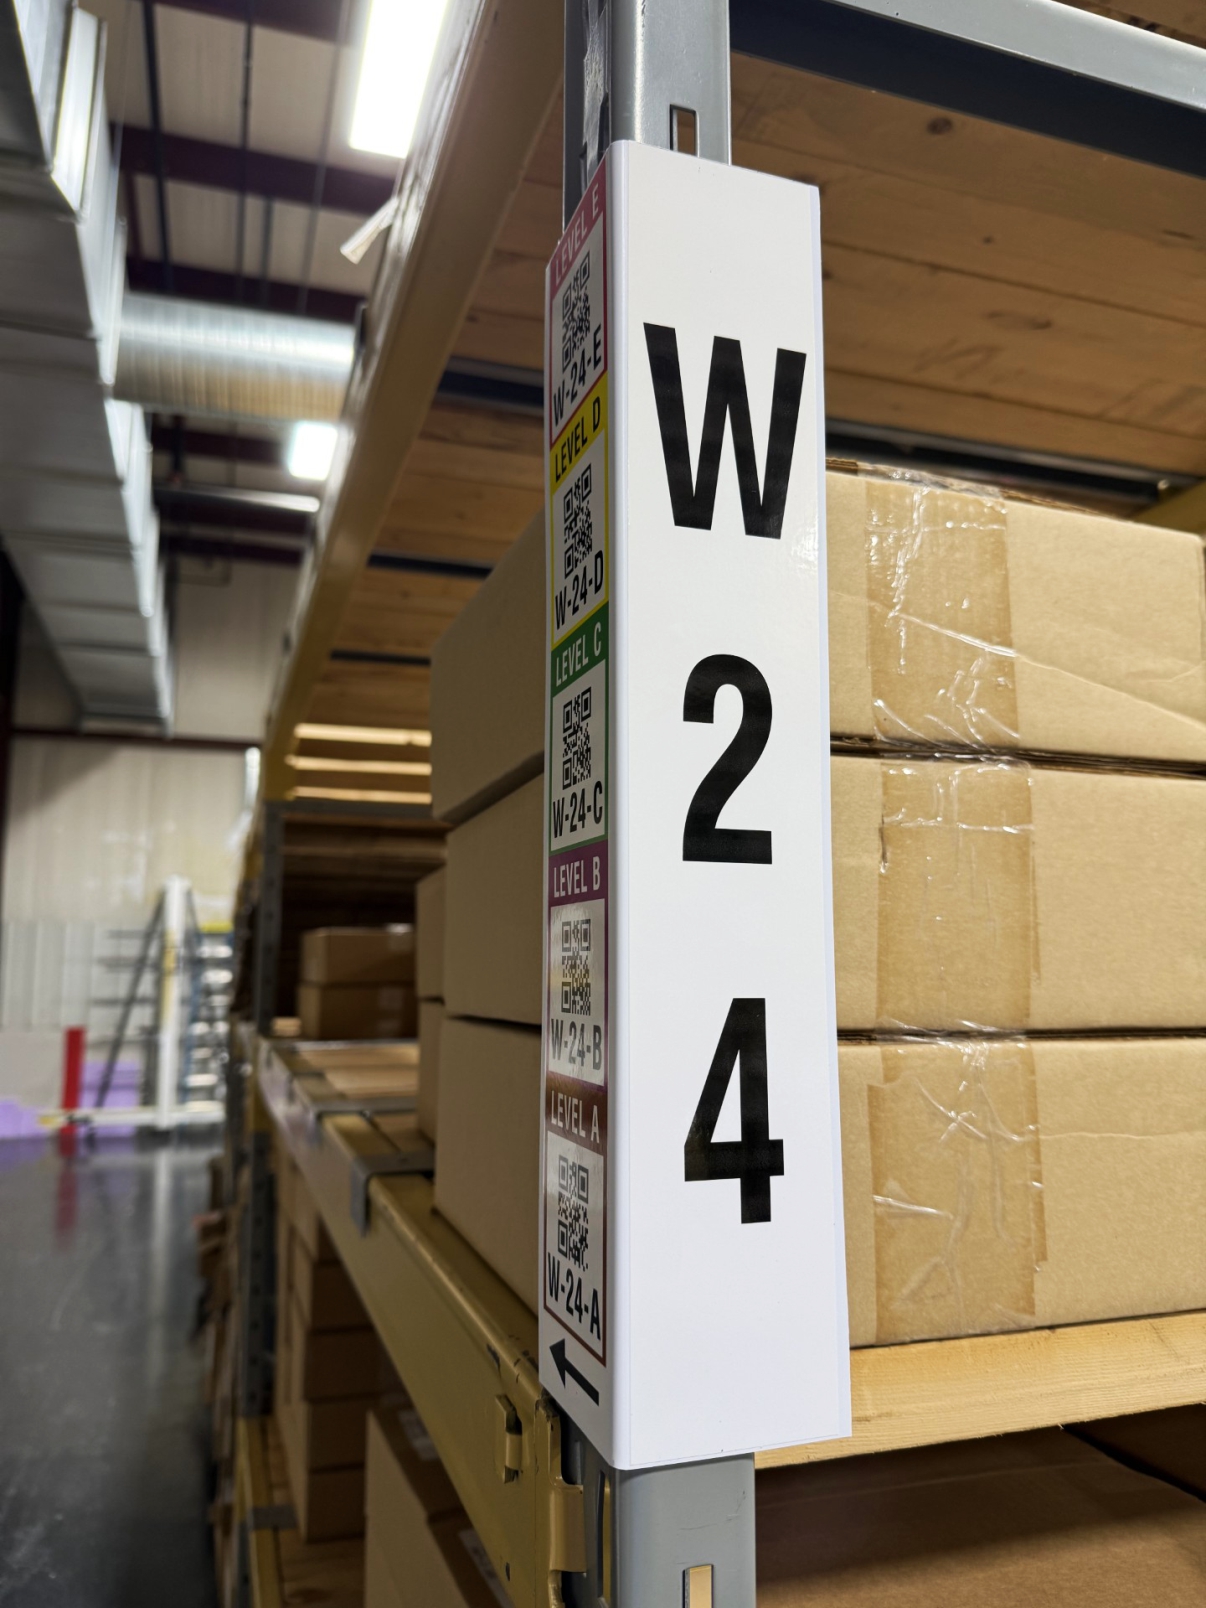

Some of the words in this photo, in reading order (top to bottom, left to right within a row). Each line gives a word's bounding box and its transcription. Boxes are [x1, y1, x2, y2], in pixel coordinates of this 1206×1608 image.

[554, 213, 588, 282] LEVEL
[592, 183, 600, 216] E
[553, 323, 602, 426] W-24-E
[555, 416, 588, 483] LEVEL
[593, 396, 600, 433] D
[644, 323, 806, 538] W
[555, 550, 604, 630] W-24-D
[556, 634, 589, 687] LEVEL
[593, 621, 602, 657] C
[683, 655, 772, 864] 2
[553, 780, 603, 838] W-24-C
[553, 860, 588, 898] LEVEL
[593, 856, 601, 891] B
[551, 1018, 602, 1071] W-24-B
[551, 1091, 586, 1138] LEVEL
[591, 1105, 600, 1144] A
[685, 998, 784, 1223] 4
[548, 1252, 601, 1340] W-24-A
